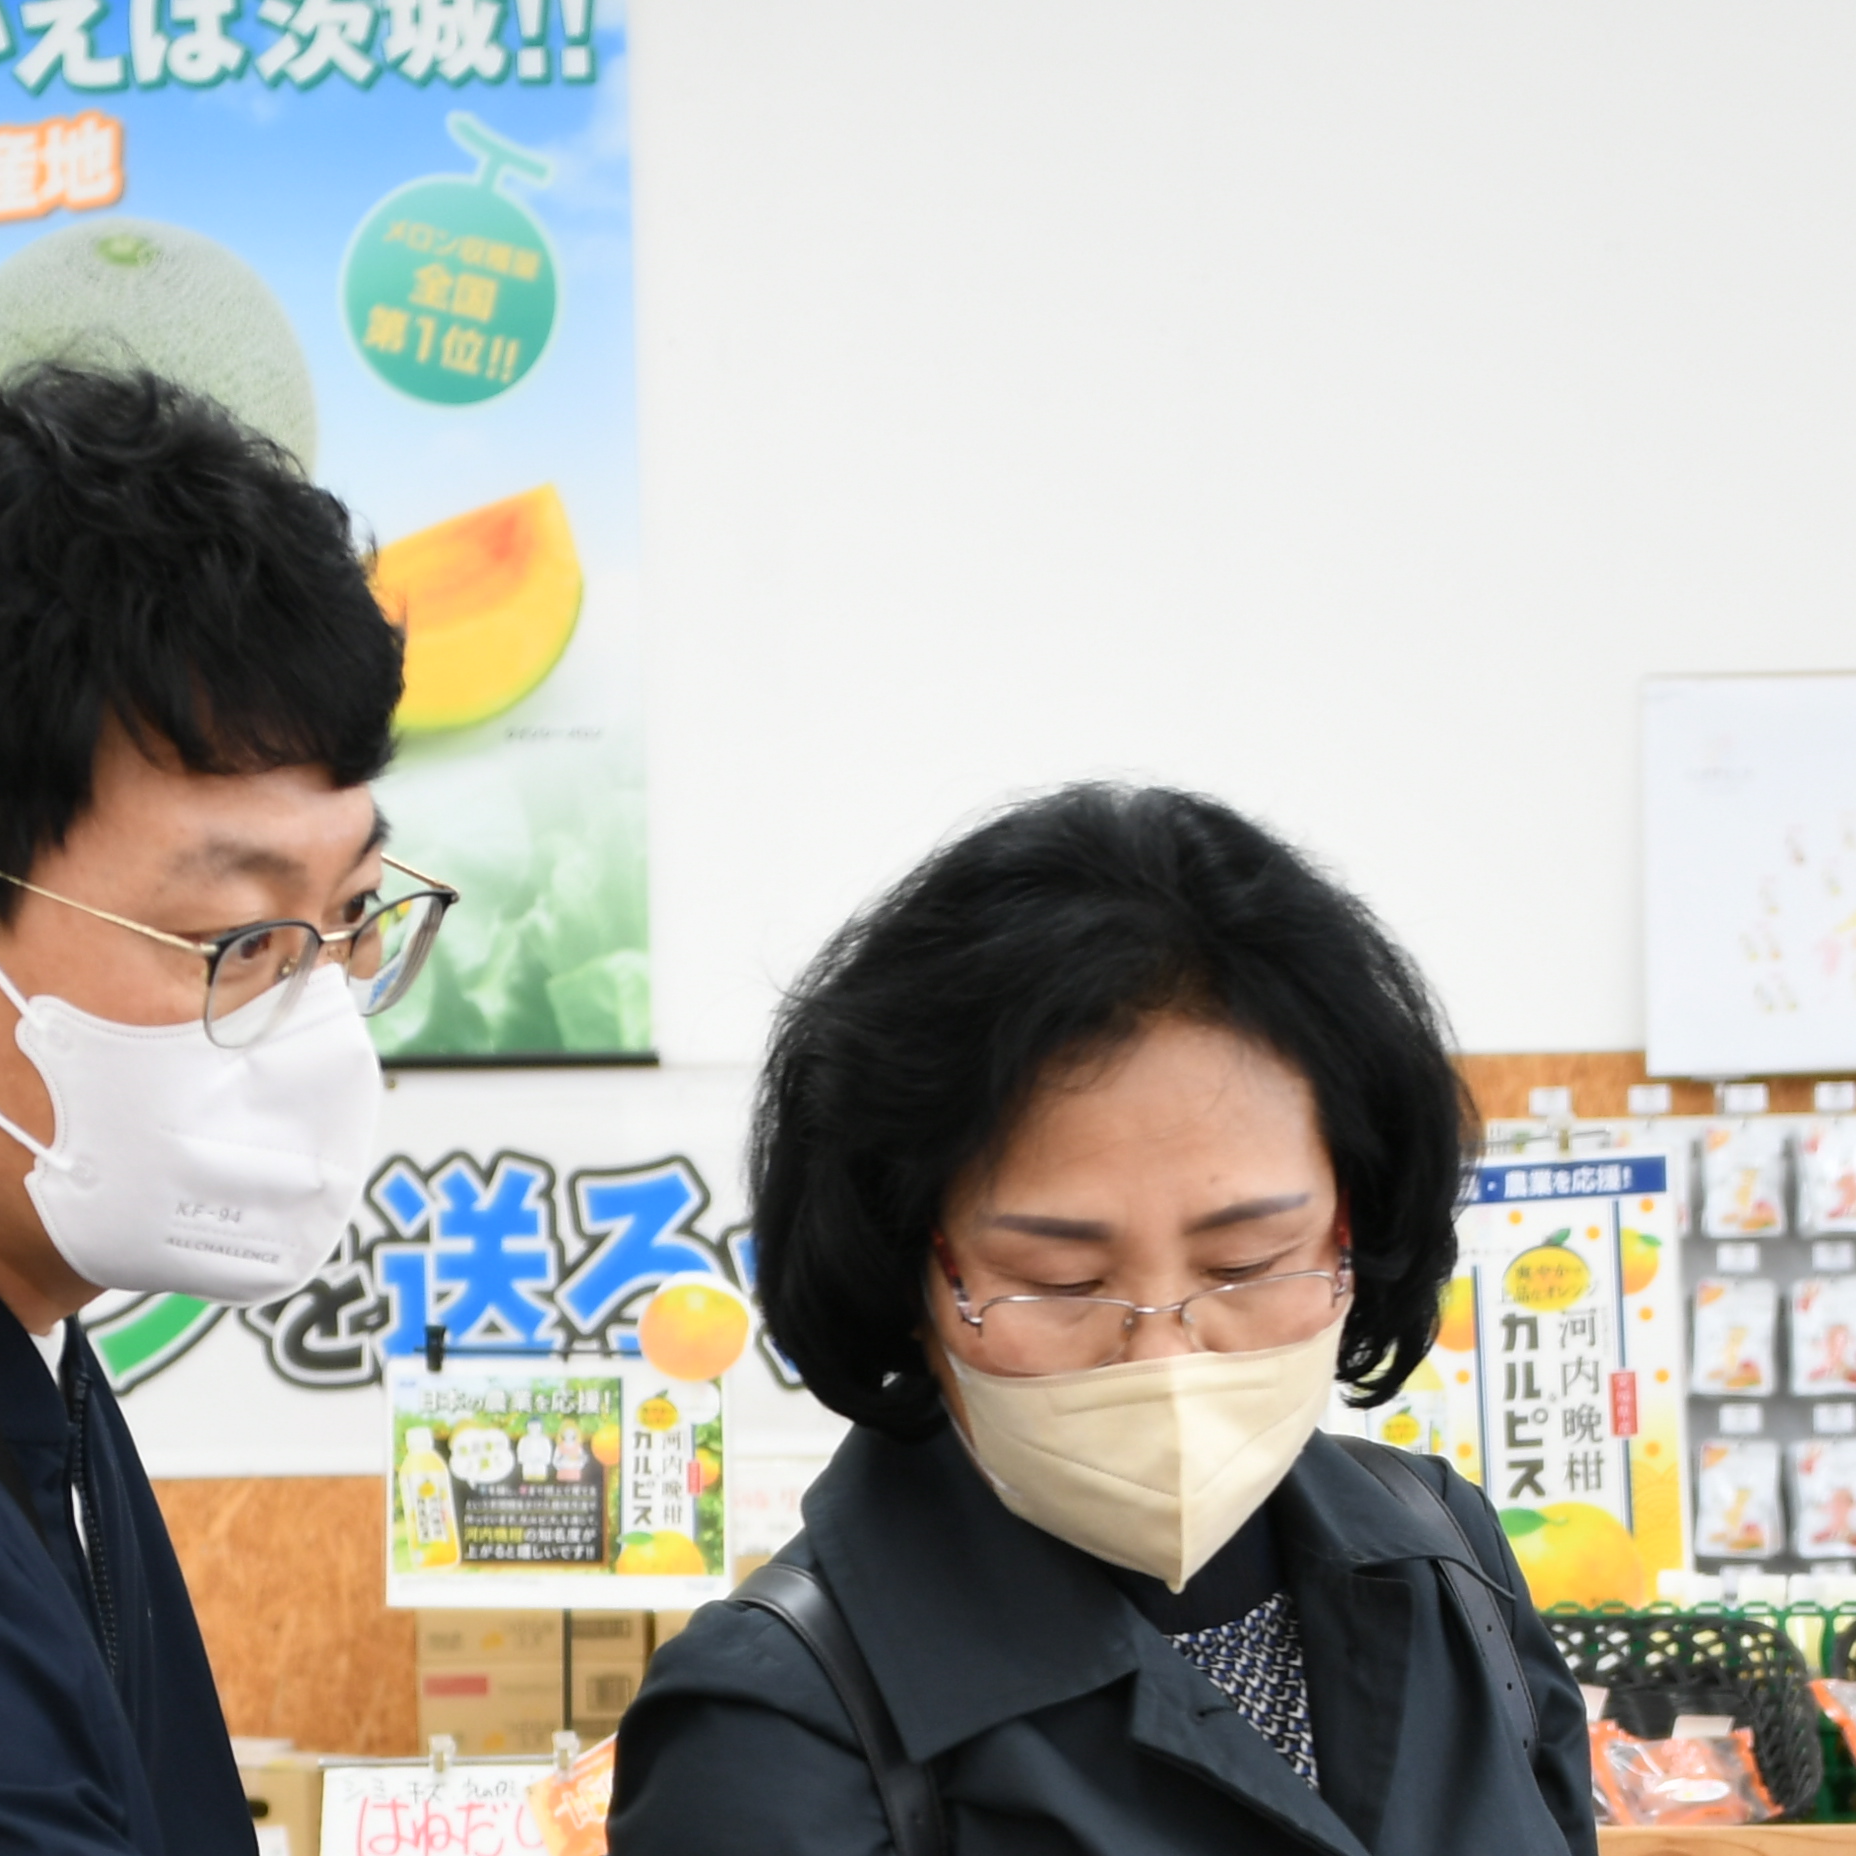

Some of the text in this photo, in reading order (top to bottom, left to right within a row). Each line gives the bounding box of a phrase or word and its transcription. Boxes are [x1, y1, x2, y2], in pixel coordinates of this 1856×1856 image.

[408, 261, 498, 323] 全国
[1500, 1312, 1549, 1499] カルピス
[1557, 1307, 1606, 1494] 河内晩柑
